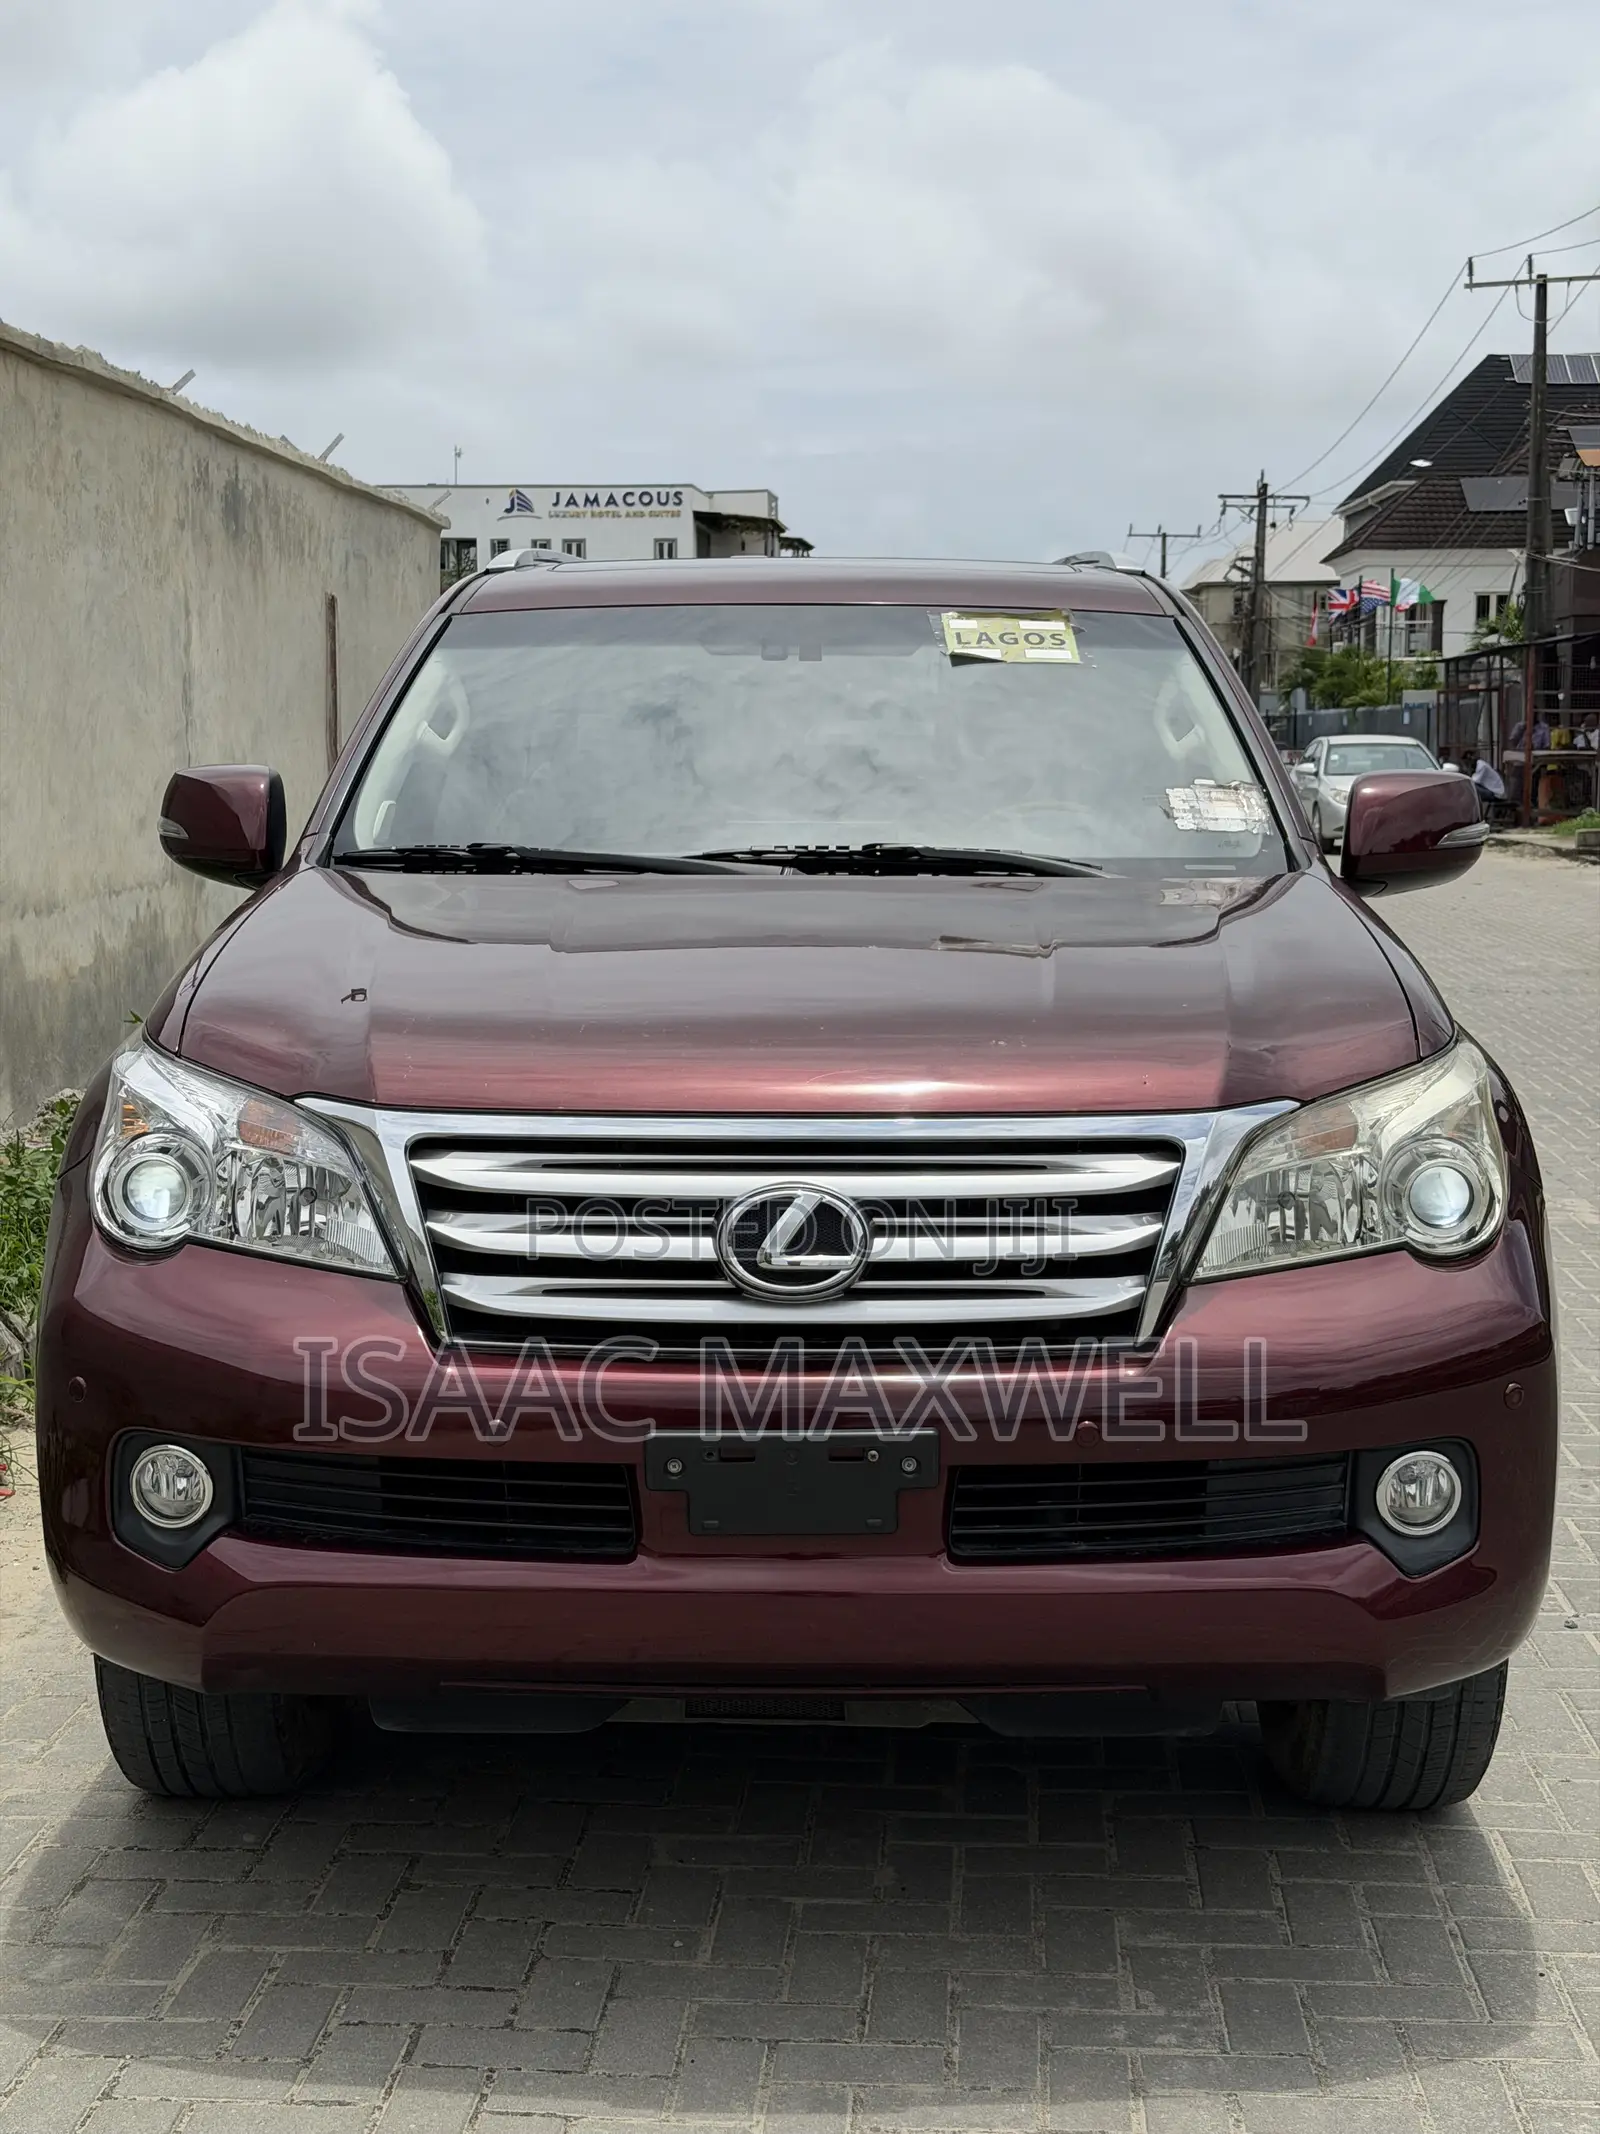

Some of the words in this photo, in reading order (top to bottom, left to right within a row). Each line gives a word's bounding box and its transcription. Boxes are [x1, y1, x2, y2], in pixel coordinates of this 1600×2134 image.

[551, 491, 683, 507] JAMACOUS
[590, 510, 622, 519] HOTEL
[625, 510, 645, 519] AND
[955, 631, 1066, 647] LAGOS
